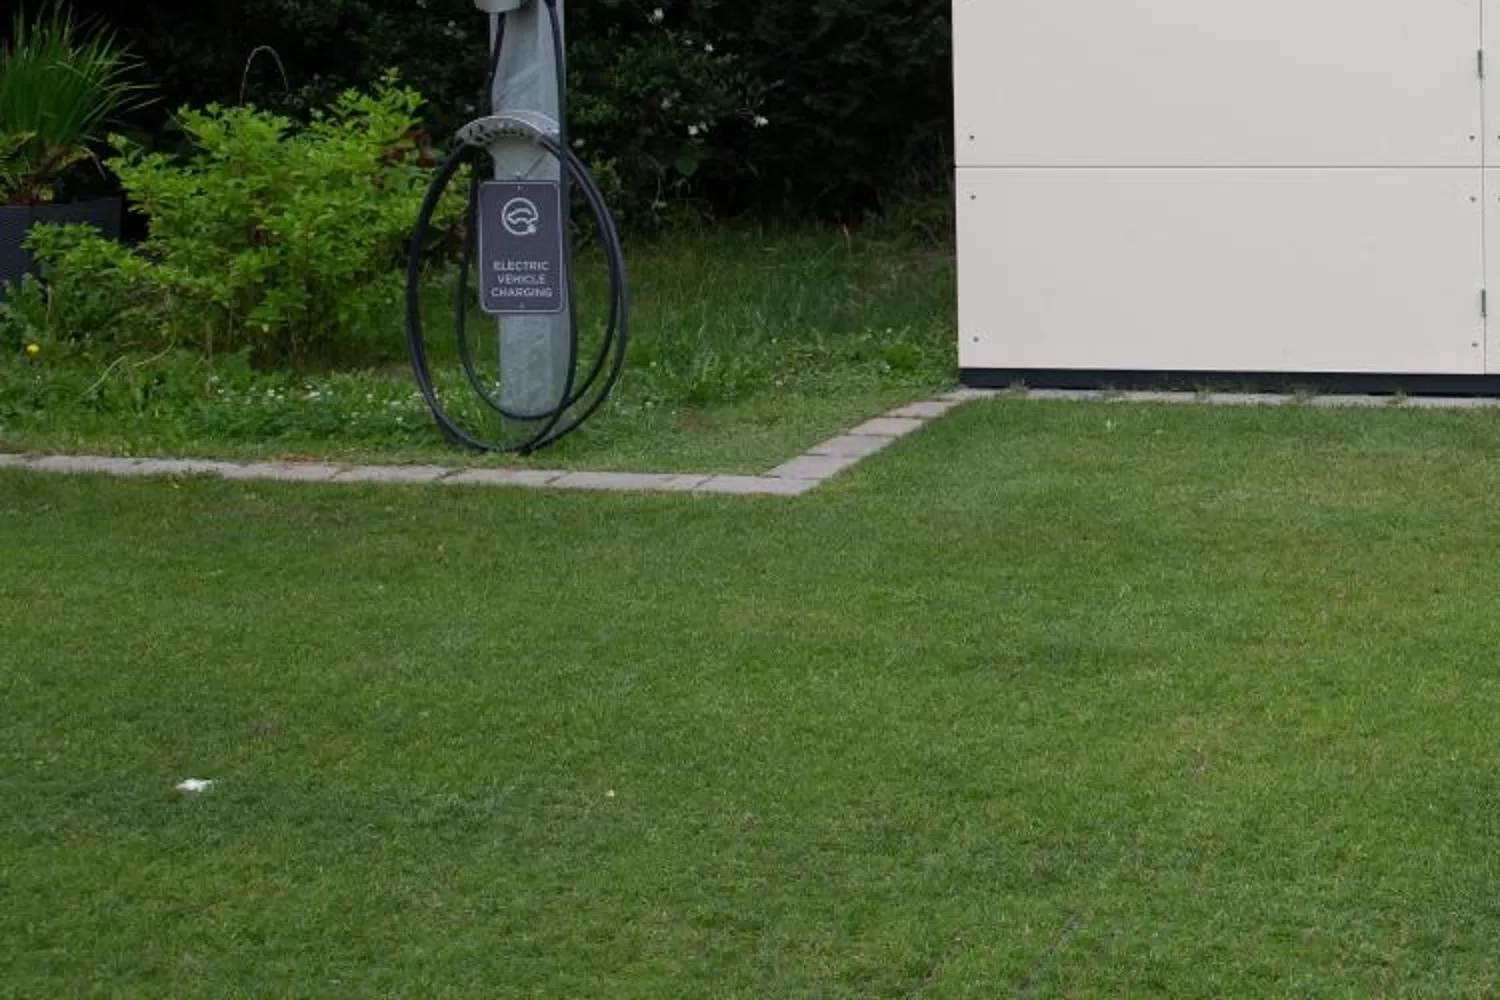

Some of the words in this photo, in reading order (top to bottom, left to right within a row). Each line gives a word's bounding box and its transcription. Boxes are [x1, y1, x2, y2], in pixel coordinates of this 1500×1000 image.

[493, 260, 549, 271] ELECTRIC
[497, 274, 546, 285] VEHICLE
[491, 287, 553, 297] CHARGING
